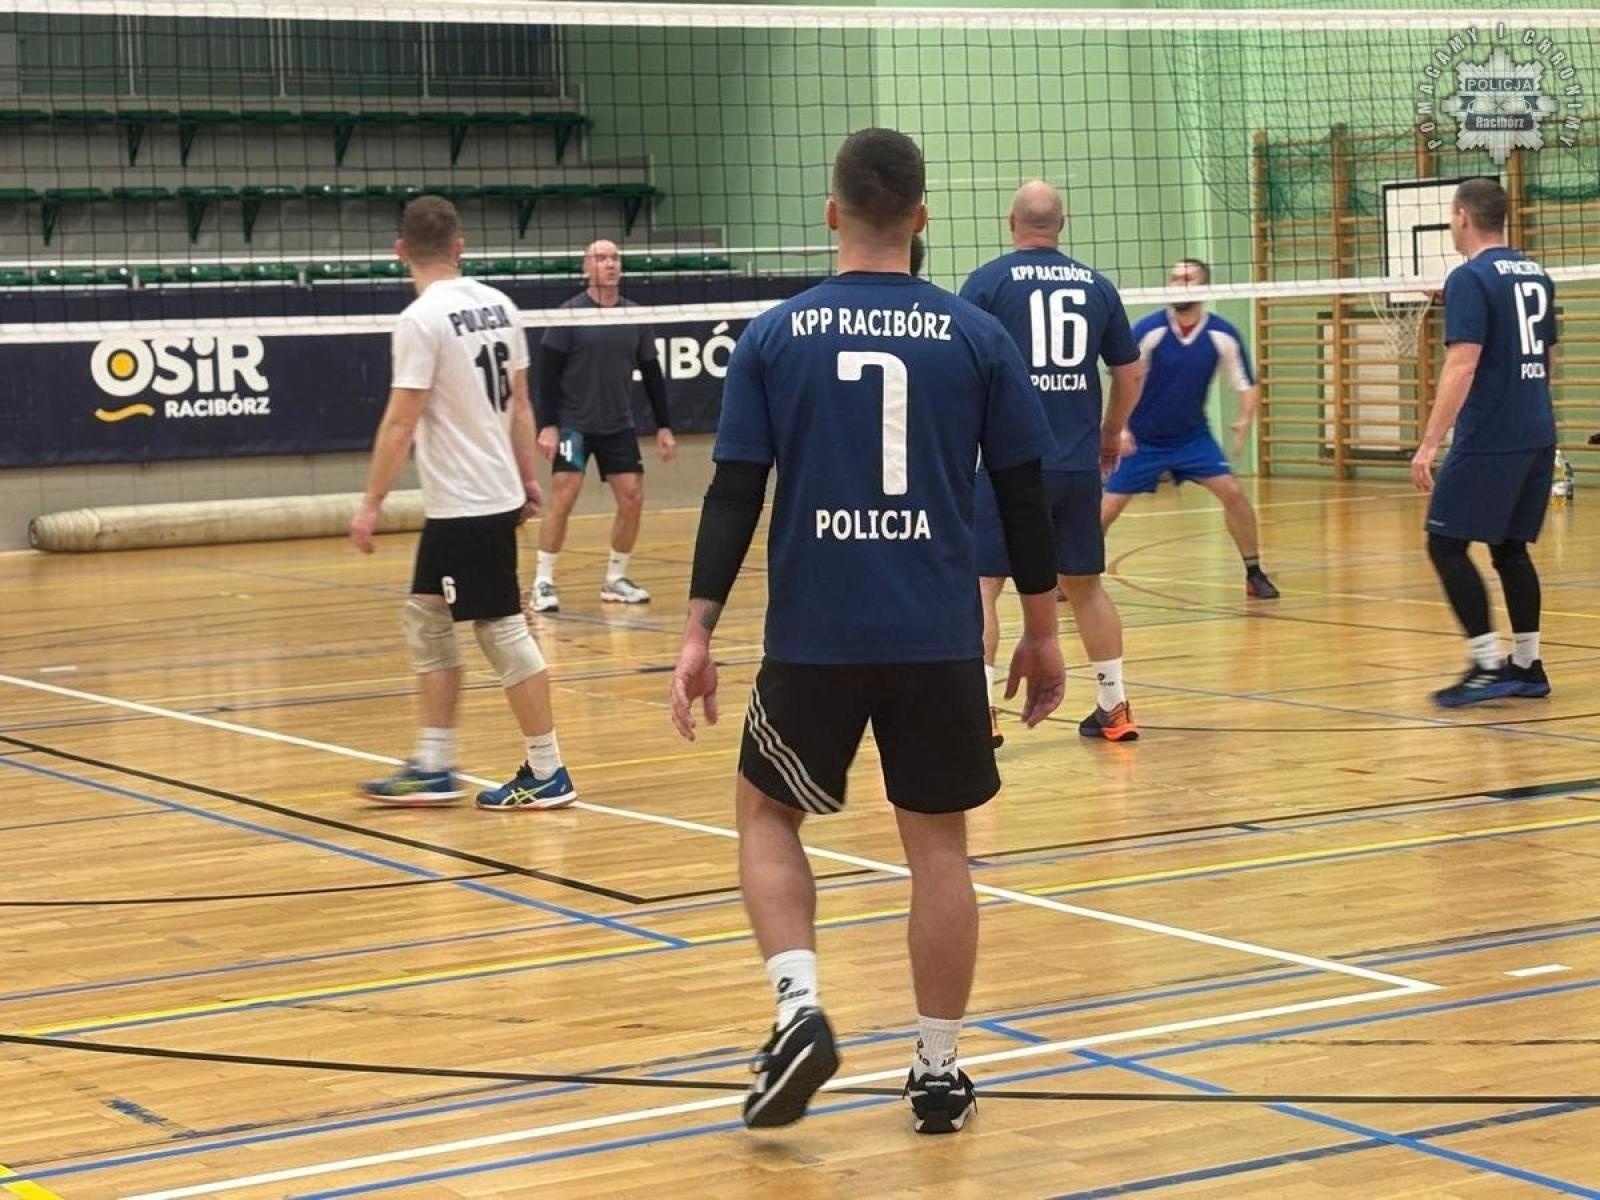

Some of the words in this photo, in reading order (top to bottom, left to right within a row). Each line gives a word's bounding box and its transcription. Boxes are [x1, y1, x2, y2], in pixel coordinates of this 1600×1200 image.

[1010, 264, 1034, 281] KPP
[1035, 263, 1094, 284] RACIBÓRZ
[791, 308, 833, 337] KPP
[838, 302, 952, 341] RACIBÓRZ
[1029, 288, 1088, 368] 16
[1514, 281, 1548, 355] 12
[1030, 373, 1088, 391] POLICJA
[164, 393, 271, 418] RACIBÓRZ
[837, 351, 908, 496] 7
[560, 440, 573, 462] 4
[815, 508, 932, 541] POLICJA
[442, 575, 457, 605] 6
